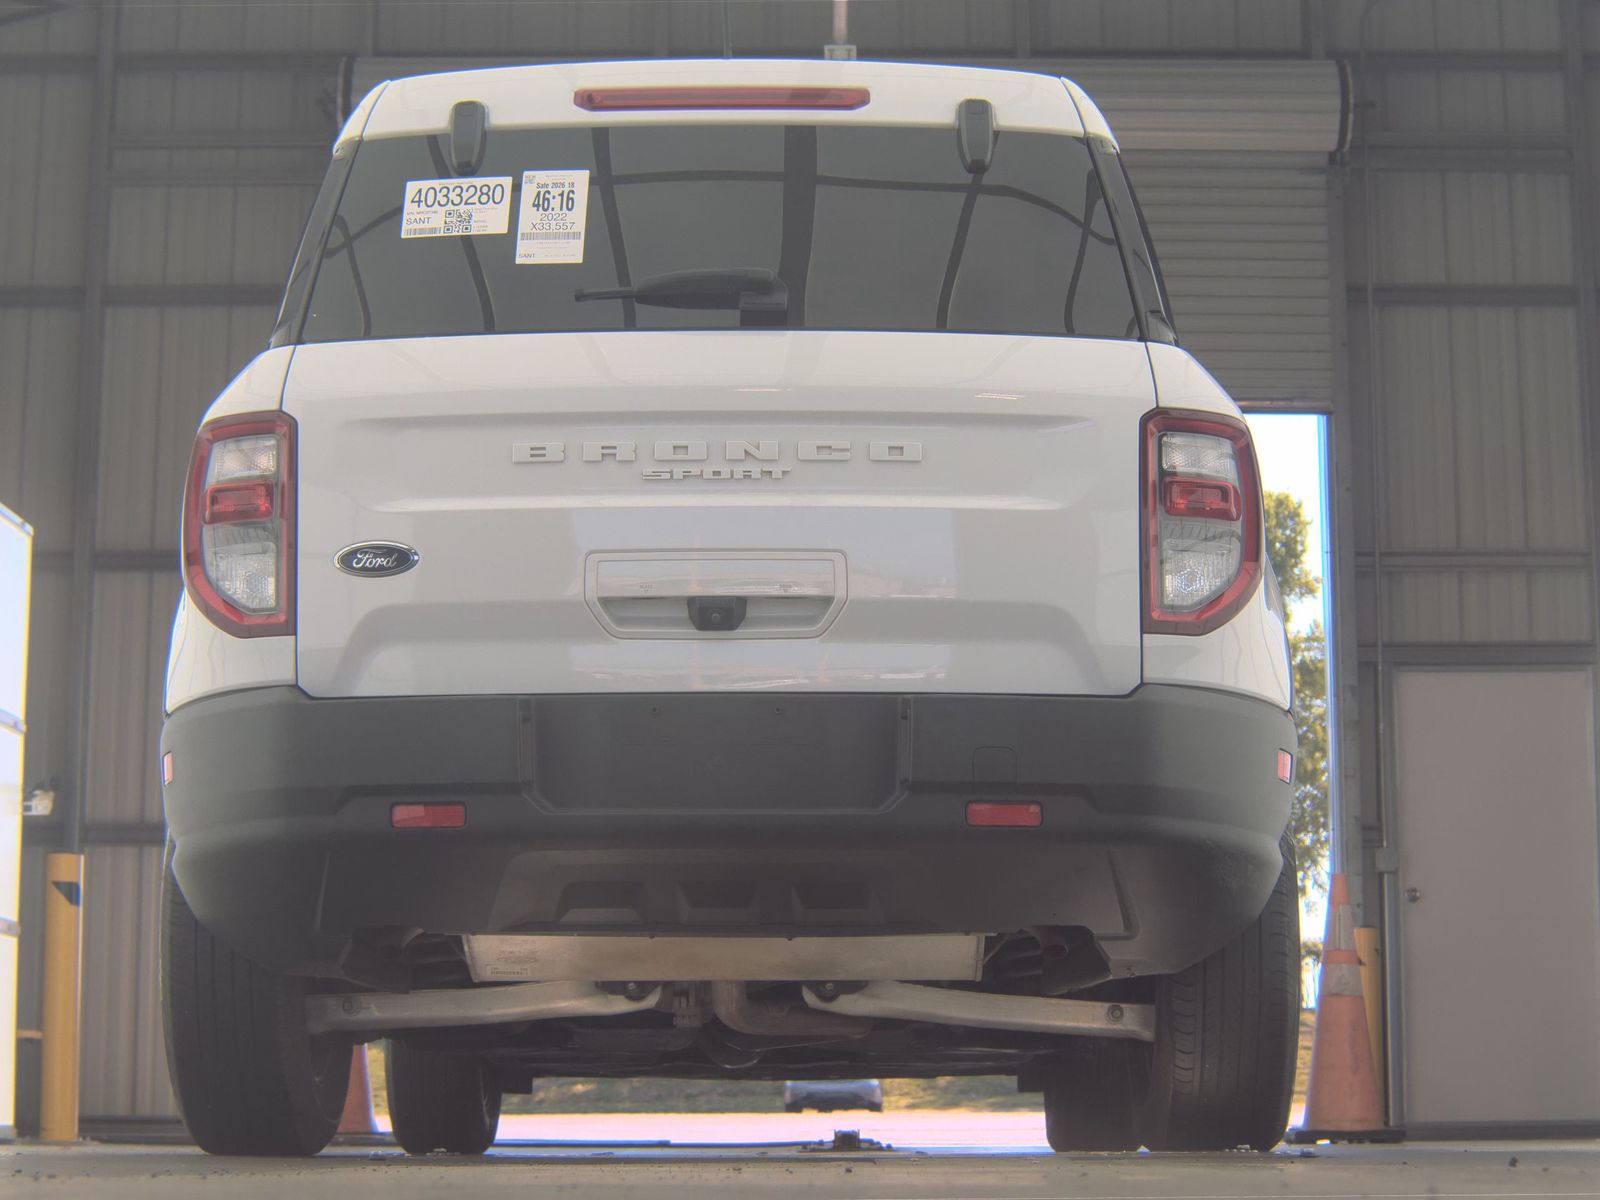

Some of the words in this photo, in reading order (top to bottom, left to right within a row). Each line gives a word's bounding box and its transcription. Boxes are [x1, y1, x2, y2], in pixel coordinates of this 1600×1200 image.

[410, 184, 505, 208] 4033280
[532, 190, 576, 212] 46:16
[405, 216, 432, 225] SANT
[539, 213, 568, 222] 2022
[530, 222, 576, 231] X33,557
[512, 440, 923, 464] BRONCO
[641, 467, 792, 481] SPORT
[352, 548, 397, 568] Ford
